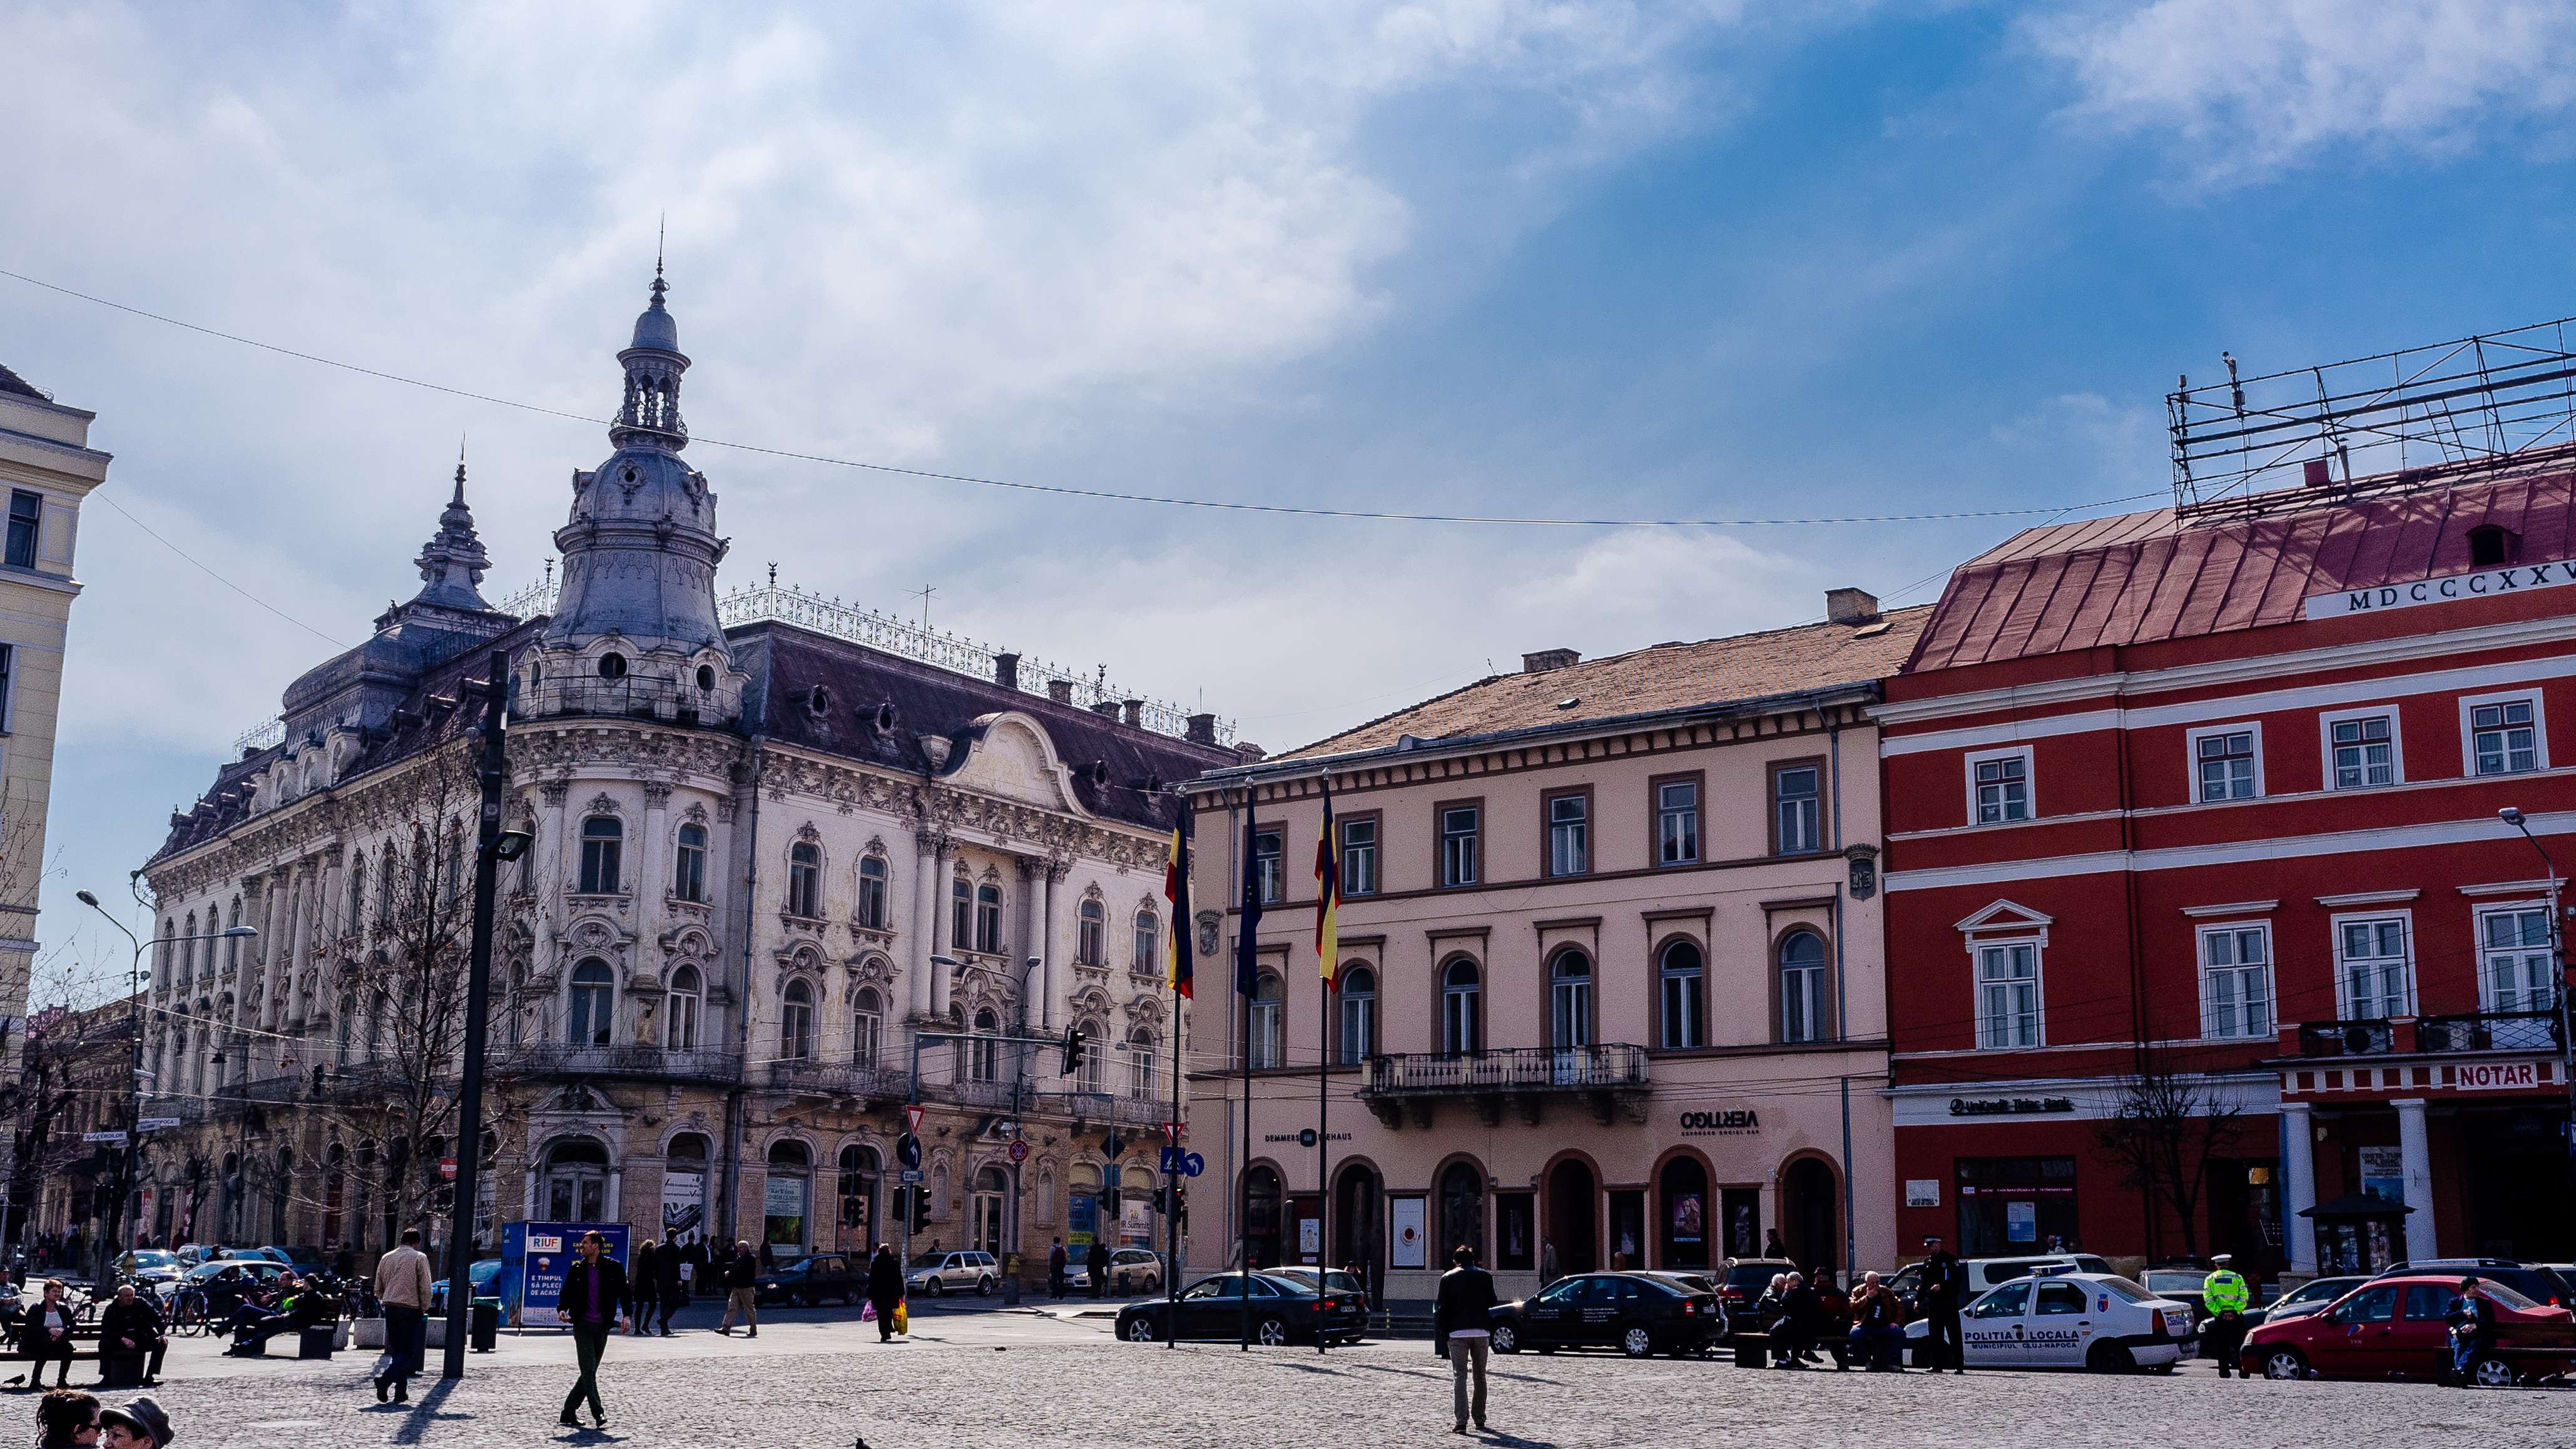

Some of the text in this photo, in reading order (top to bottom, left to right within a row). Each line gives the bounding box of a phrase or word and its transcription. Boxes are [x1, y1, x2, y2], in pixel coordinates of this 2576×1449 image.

[2460, 1065, 2533, 1086] NOTAR
[1680, 1110, 1759, 1129] VERTIGO
[1265, 1134, 1300, 1142] DEMMERS
[1318, 1132, 1352, 1141] TEHAUS
[1128, 1220, 1150, 1229] Summit
[533, 1238, 558, 1248] RIUF
[1965, 1330, 2079, 1341] POLITIA LOCALA
